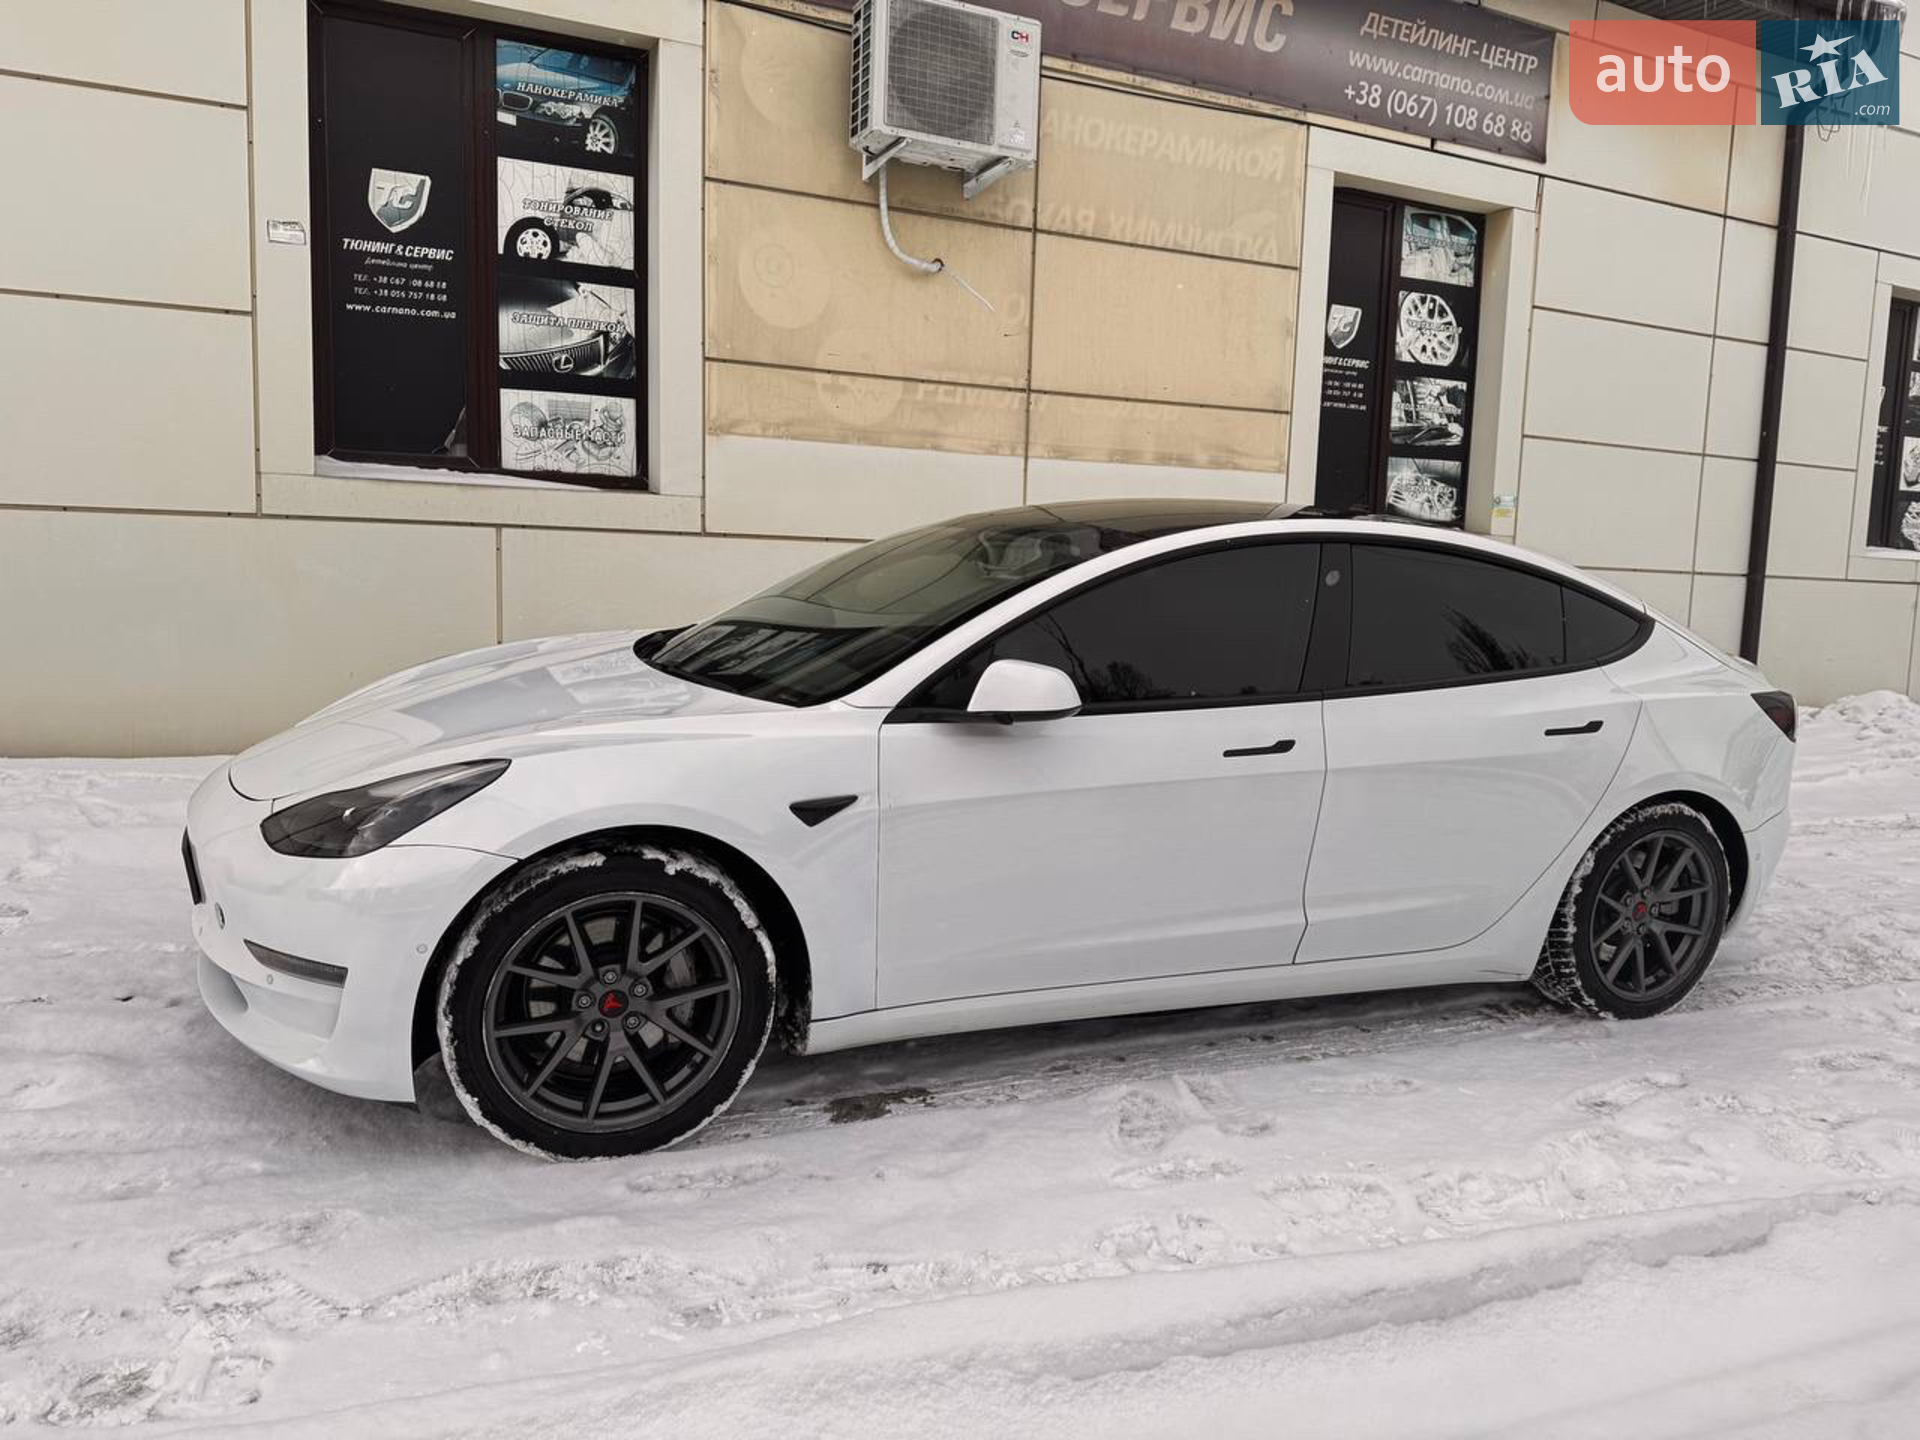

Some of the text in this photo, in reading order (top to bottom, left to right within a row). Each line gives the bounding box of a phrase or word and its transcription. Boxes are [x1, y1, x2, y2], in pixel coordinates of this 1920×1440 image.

[1360, 12, 1539, 75] ДЕТЕЙЛИНГ-ЦЕНТР
[517, 82, 619, 107] НАНОКЕРАМИКА
[1344, 81, 1533, 143] +38 (067) 108 68 88
[523, 198, 614, 221] ТОНИРОВАНИЕ
[543, 216, 595, 232] СТЕКОЛ
[346, 302, 457, 319] www.carnano.com.ua
[511, 312, 565, 328] ЗАЩИТА
[513, 425, 625, 444] ЗАПАСНЫЕ ЧАСТИ
